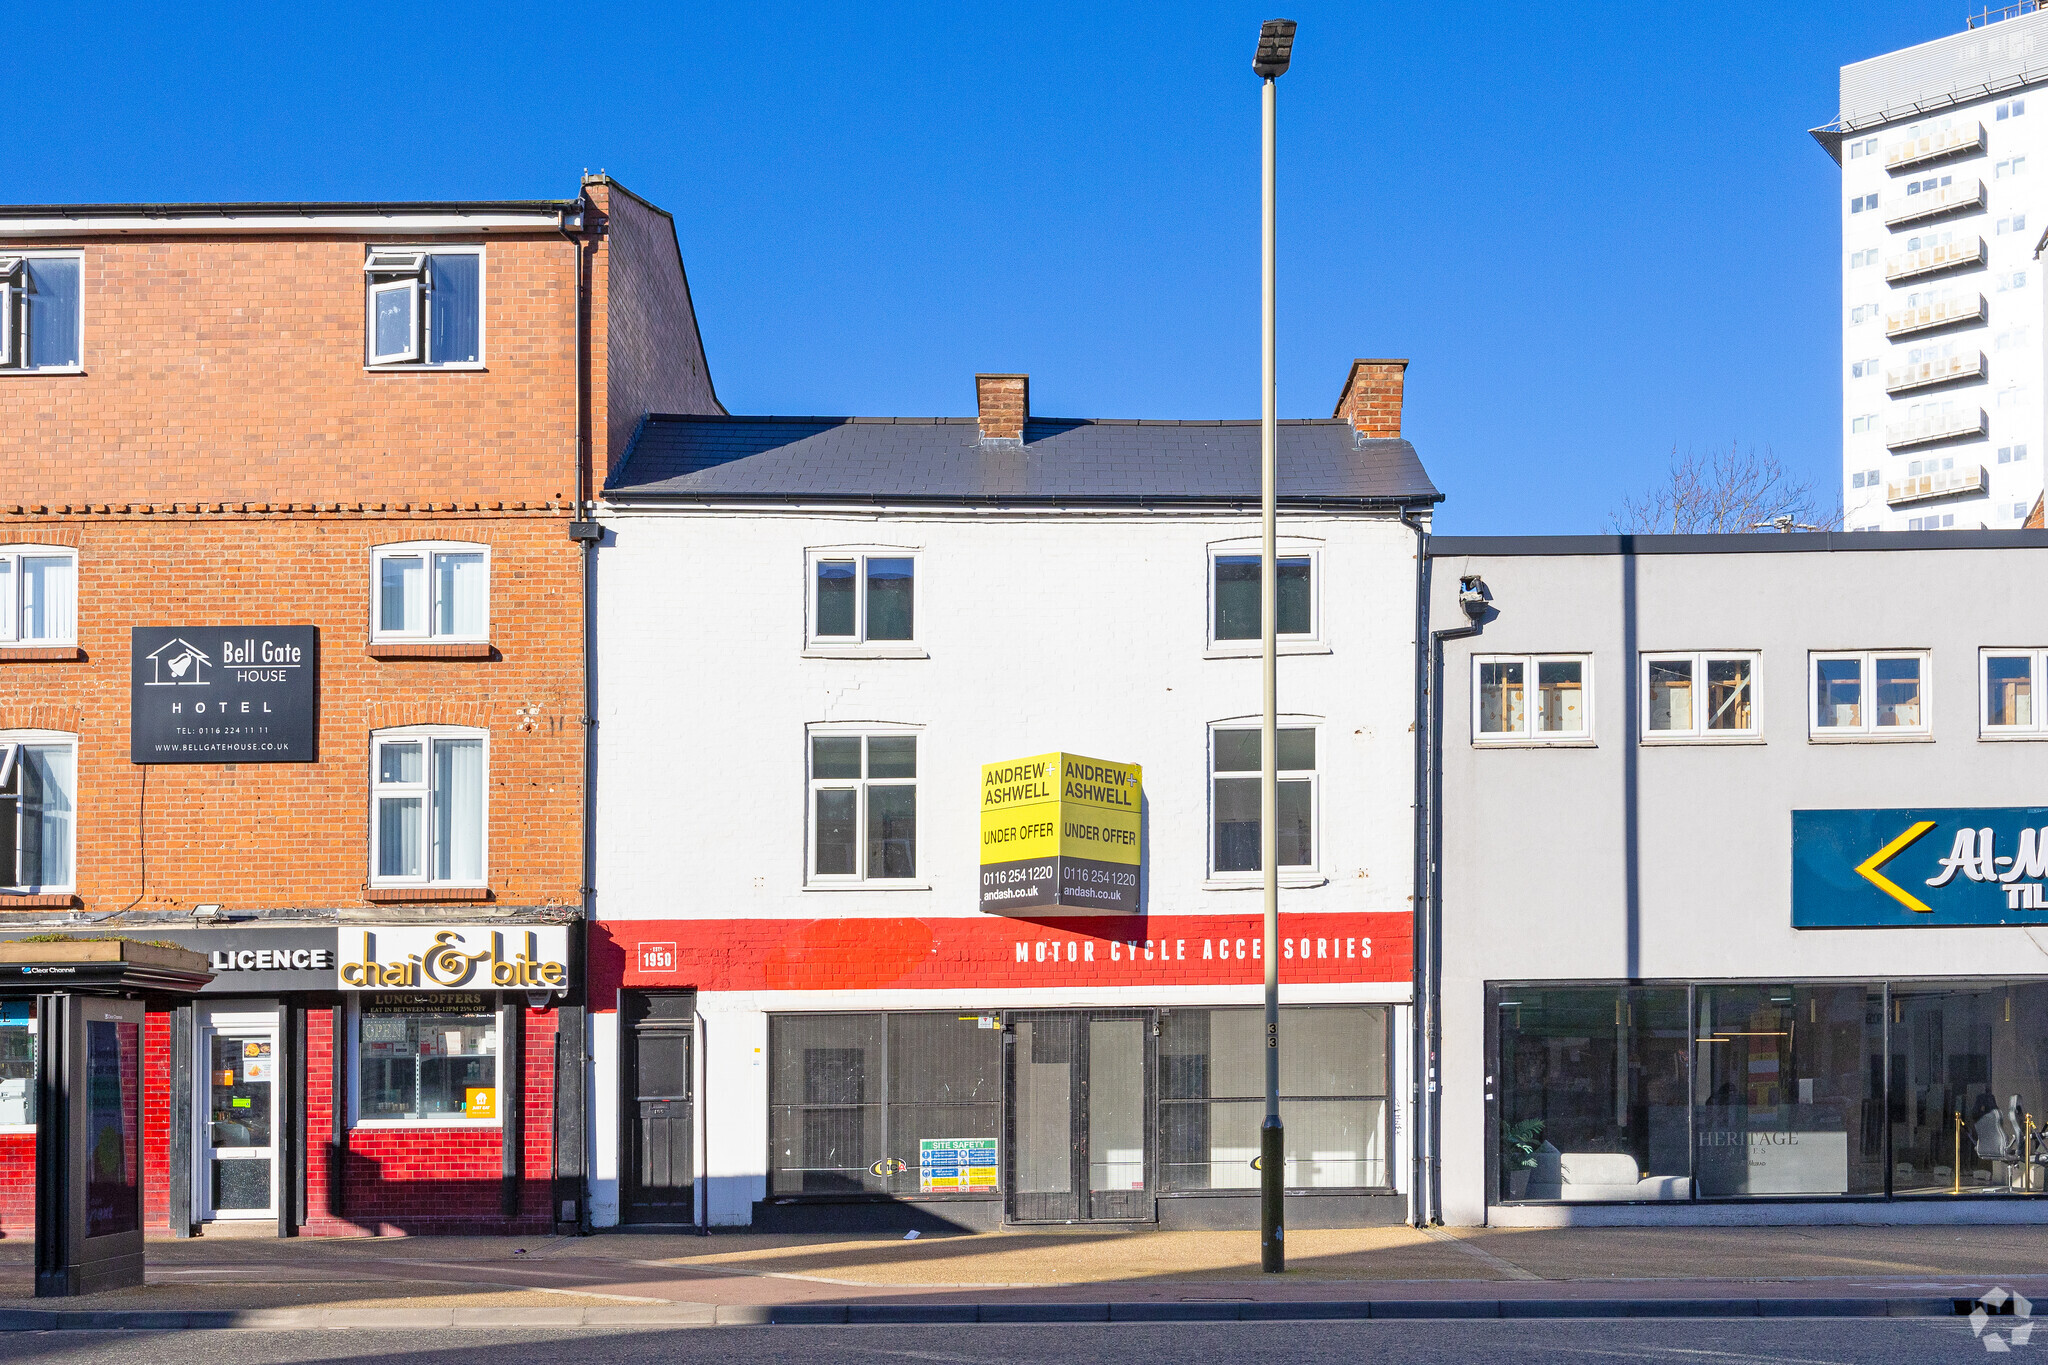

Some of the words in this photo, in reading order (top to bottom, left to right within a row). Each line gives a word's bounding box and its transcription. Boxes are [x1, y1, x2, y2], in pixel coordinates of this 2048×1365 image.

[223, 639, 255, 663] Bell
[261, 640, 301, 663] Gate
[237, 670, 287, 682] HOUSE
[172, 702, 272, 714] HOTEL
[176, 727, 195, 735] TEL:
[224, 726, 241, 734] 224
[244, 726, 254, 734] 11
[259, 726, 269, 734] 11
[154, 743, 289, 752] WWW.BELLGATEHOUSE.CO.UK
[984, 781, 1050, 806] ASHWELL
[1065, 781, 1132, 806] ASHWELL
[984, 827, 1017, 845] UNDER
[1019, 822, 1054, 840] OFFER
[1064, 822, 1100, 841] UNDER
[1102, 827, 1136, 846] OFFER
[983, 869, 1007, 886] 0116
[1008, 868, 1027, 883] 254
[1028, 865, 1053, 881] 1220
[1063, 866, 1089, 882] 0116
[1090, 869, 1110, 884] 254
[1111, 872, 1136, 887] 1220
[984, 885, 1039, 901] andash.co.uk
[1064, 885, 1122, 901] andash.co.uk
[340, 930, 413, 986] chai
[422, 930, 487, 986] &
[491, 930, 563, 985] bite
[1016, 941, 1095, 963] MOTOR
[1111, 939, 1186, 962] CYCLE
[1202, 937, 1372, 960] ACCESORIES
[213, 949, 327, 969] LICENCE
[643, 952, 672, 967] 1950
[429, 993, 481, 1004] OFFERS
[365, 1023, 404, 1038] OPEN
[1269, 1024, 1277, 1034] 3
[1269, 1037, 1277, 1047] 3
[952, 1141, 985, 1149] SAFETY
[1698, 1131, 1799, 1146] HERITAGE
